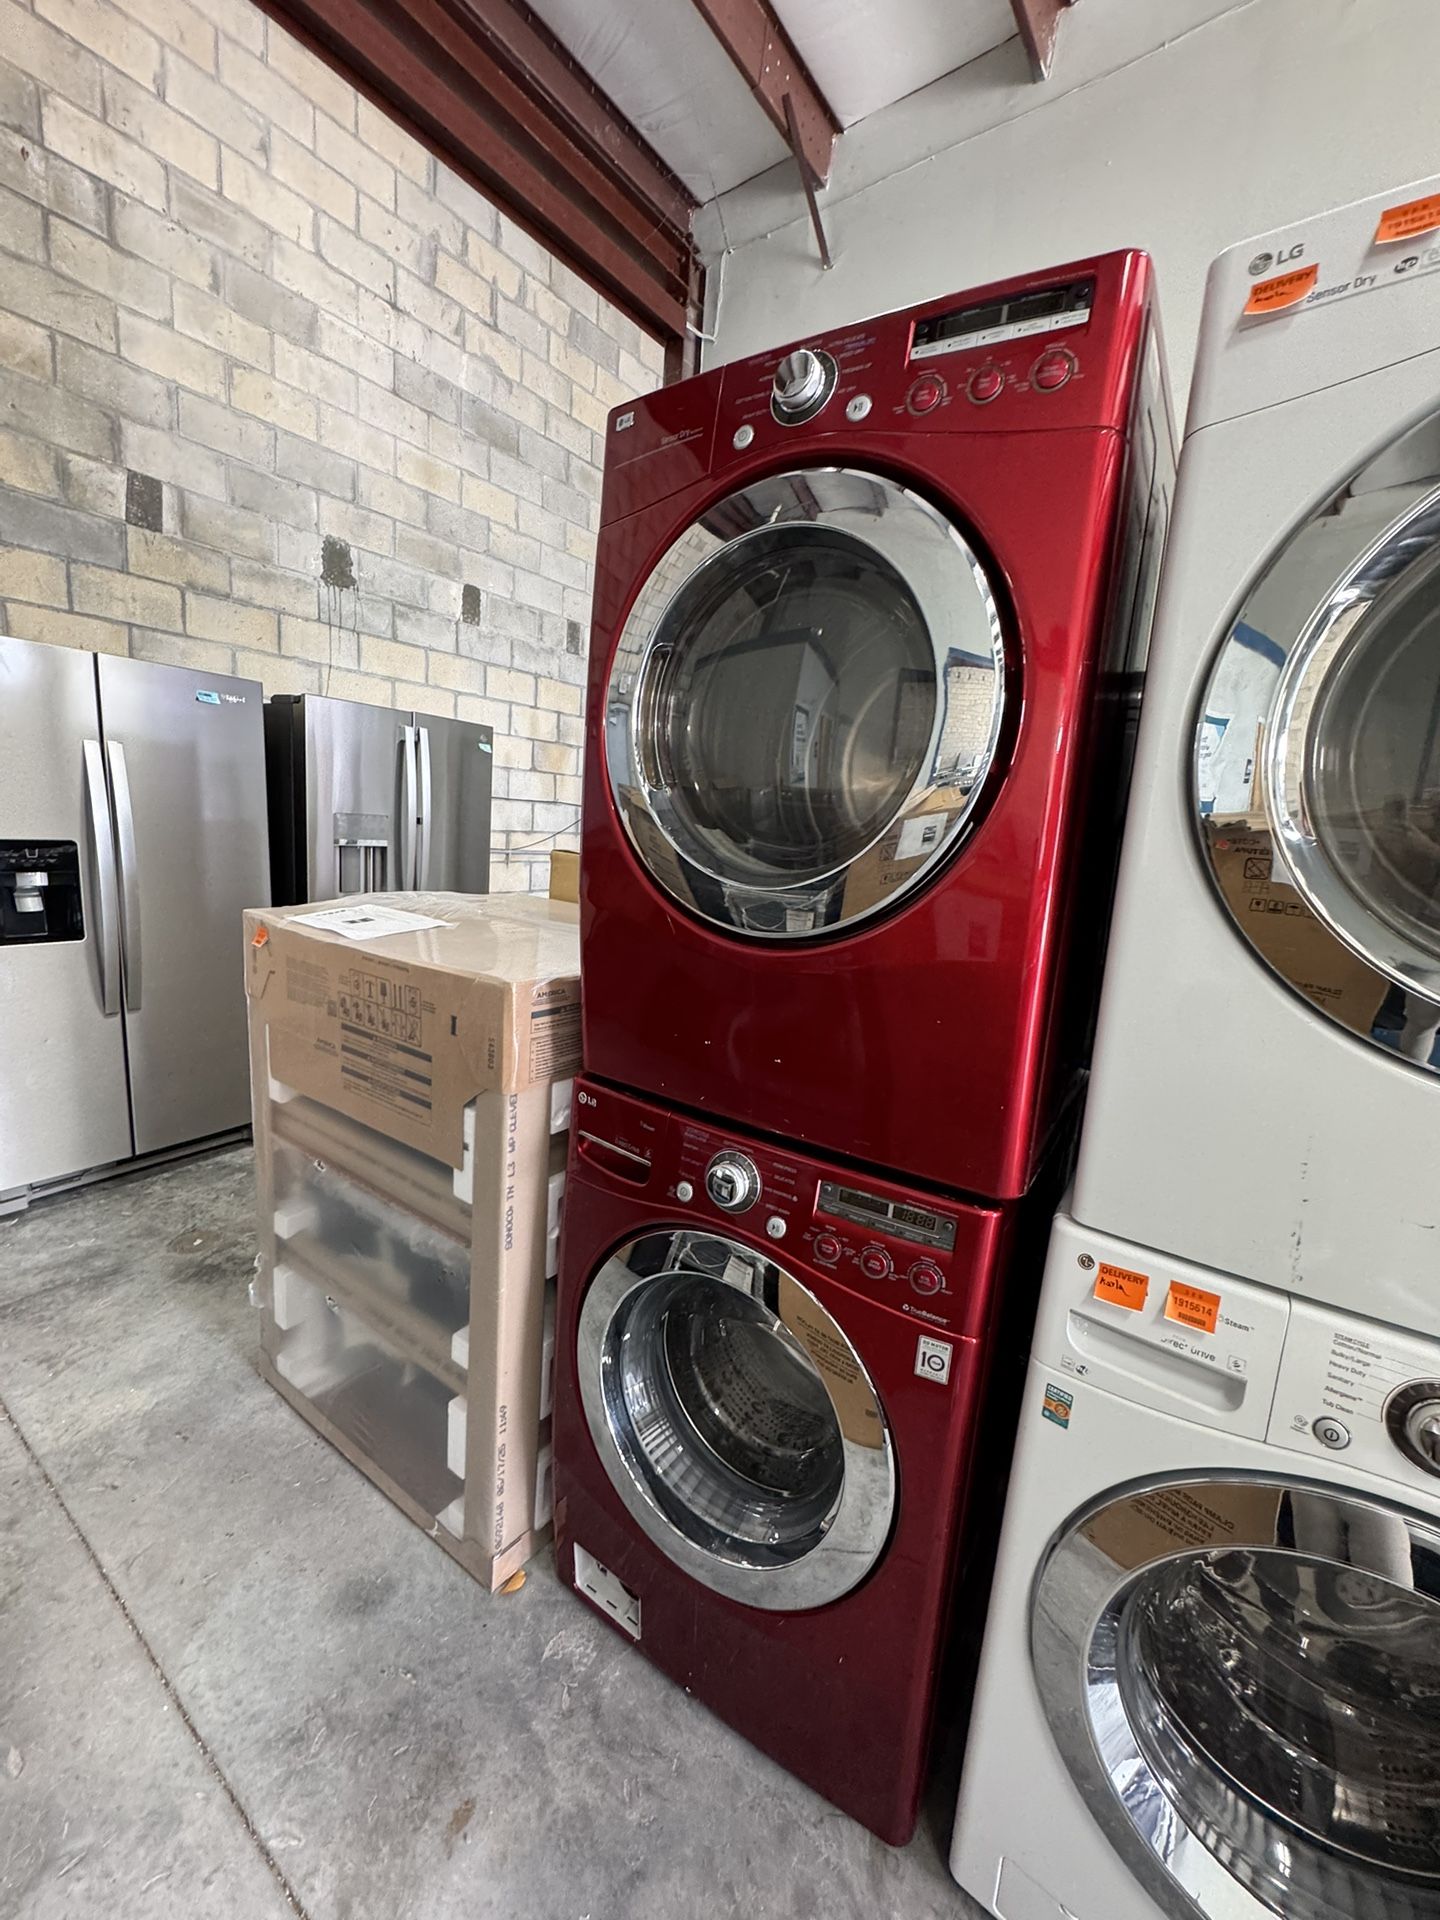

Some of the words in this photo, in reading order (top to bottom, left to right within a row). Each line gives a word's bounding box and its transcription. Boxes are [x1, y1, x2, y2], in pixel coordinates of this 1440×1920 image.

[1277, 243, 1304, 265] LG
[1253, 269, 1313, 295] DELIVERY
[1306, 281, 1350, 303] Sensor
[1353, 273, 1377, 292] Dry
[588, 1096, 597, 1107] LG
[1101, 1266, 1145, 1285] DELIVERY
[921, 1351, 945, 1372] 10
[1329, 1360, 1349, 1372] Heavy
[1351, 1367, 1367, 1378] Duty
[1327, 1372, 1355, 1387] Sanitary
[1322, 1398, 1334, 1408] Tub
[1335, 1404, 1354, 1415] Clean
